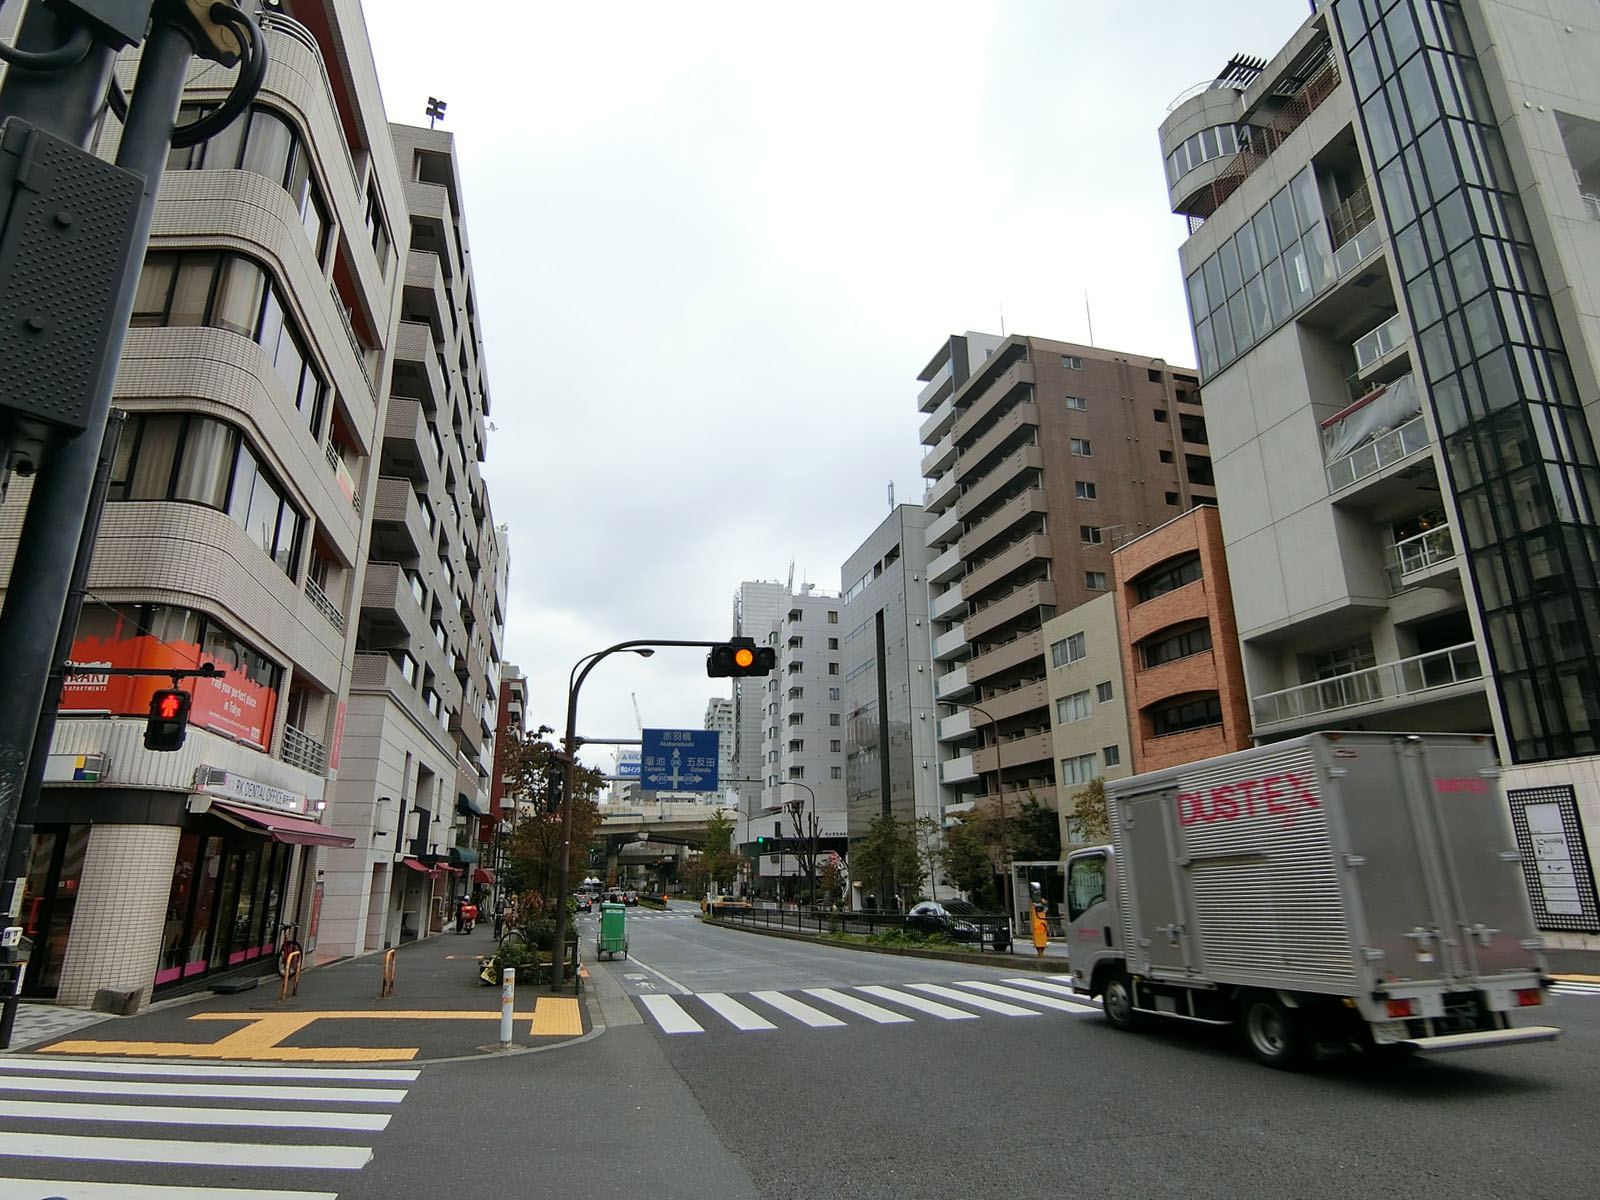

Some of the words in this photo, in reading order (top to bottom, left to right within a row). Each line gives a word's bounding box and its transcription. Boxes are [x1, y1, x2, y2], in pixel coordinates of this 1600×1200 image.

[221, 681, 233, 694] your
[231, 687, 247, 703] perfect
[246, 694, 257, 707] place
[229, 701, 242, 717] Tokyo
[687, 757, 715, 767] 五反田
[243, 782, 266, 801] DENTAL
[266, 788, 283, 806] OFFICE
[1177, 770, 1320, 827] DUSTEX
